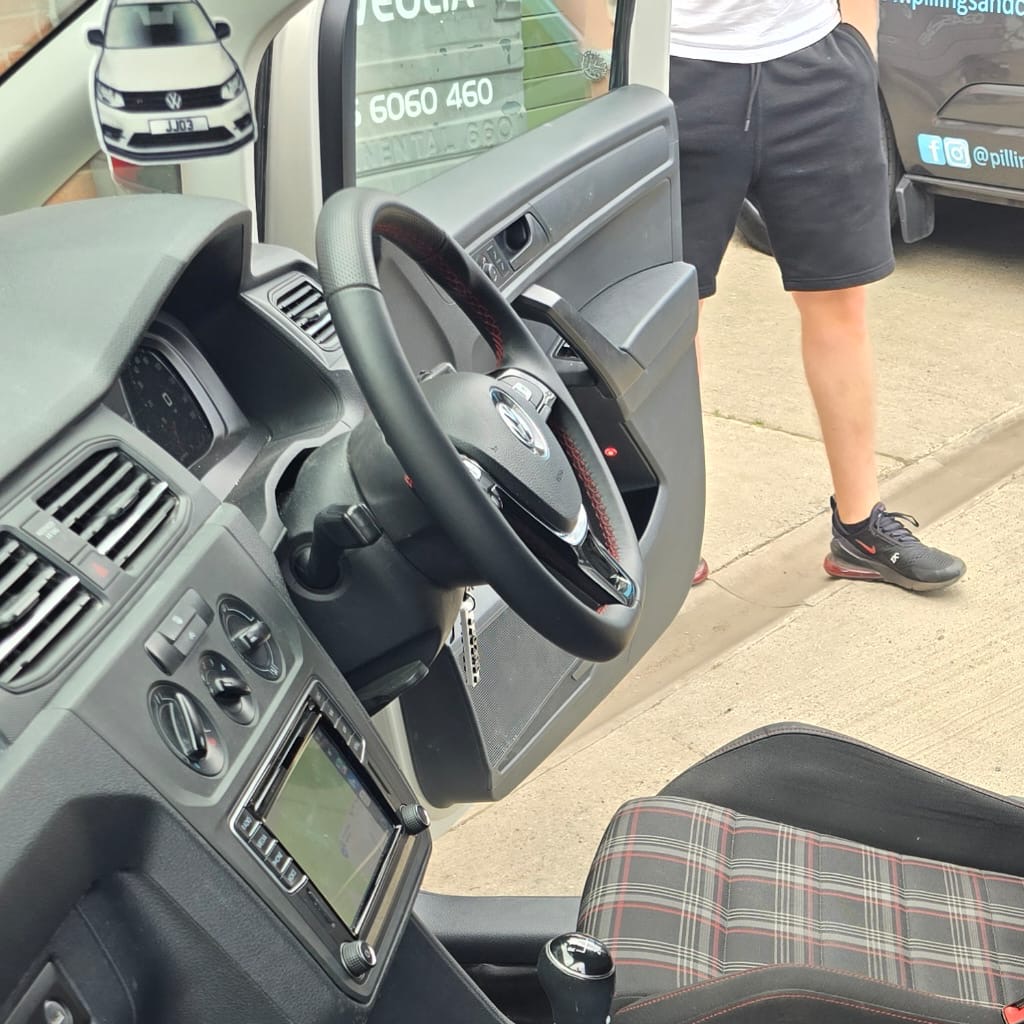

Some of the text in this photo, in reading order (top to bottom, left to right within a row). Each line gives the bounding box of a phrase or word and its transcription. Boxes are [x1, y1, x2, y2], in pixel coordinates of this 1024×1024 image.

[356, 0, 475, 26] EOL
[369, 86, 438, 124] 6060
[446, 77, 493, 109] 460
[165, 119, 194, 132] JJ03
